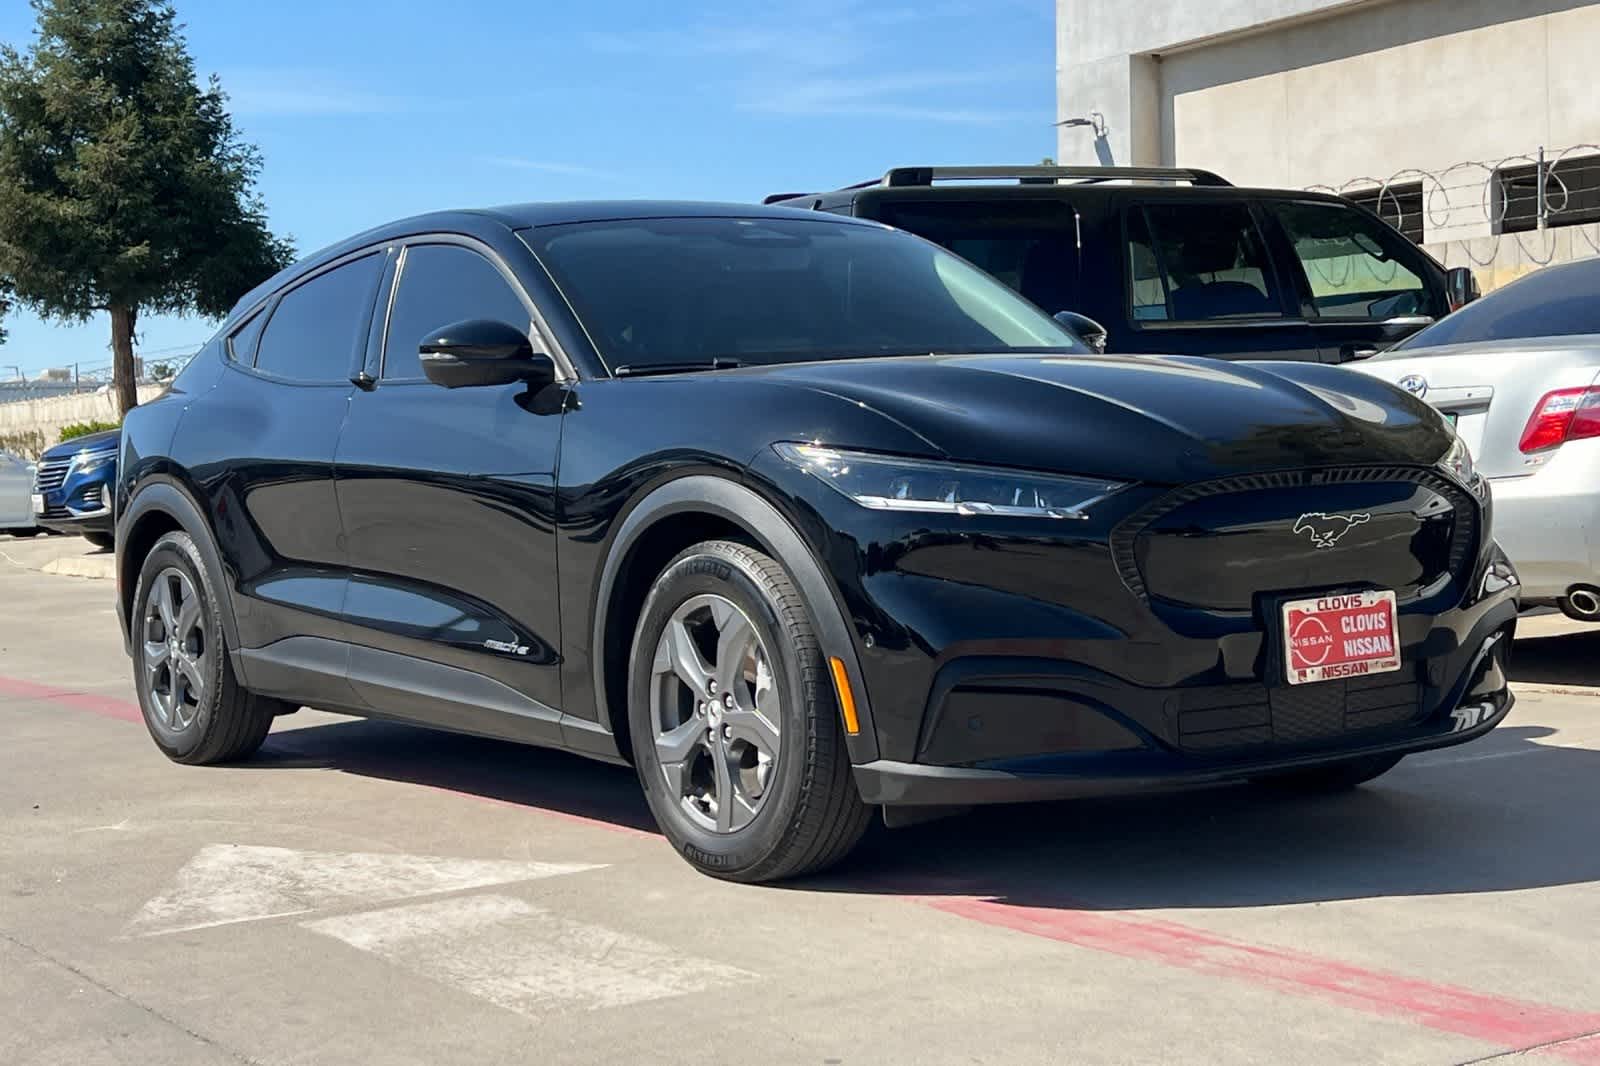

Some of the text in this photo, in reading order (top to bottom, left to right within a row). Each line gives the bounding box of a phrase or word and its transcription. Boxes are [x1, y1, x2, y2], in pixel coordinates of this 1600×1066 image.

[1317, 595, 1362, 611] CLOVIS
[1341, 612, 1386, 633] CLOVIS
[1290, 635, 1333, 647] NISSAN
[1343, 635, 1392, 657] NISSAN
[1322, 662, 1369, 679] NISSAN
